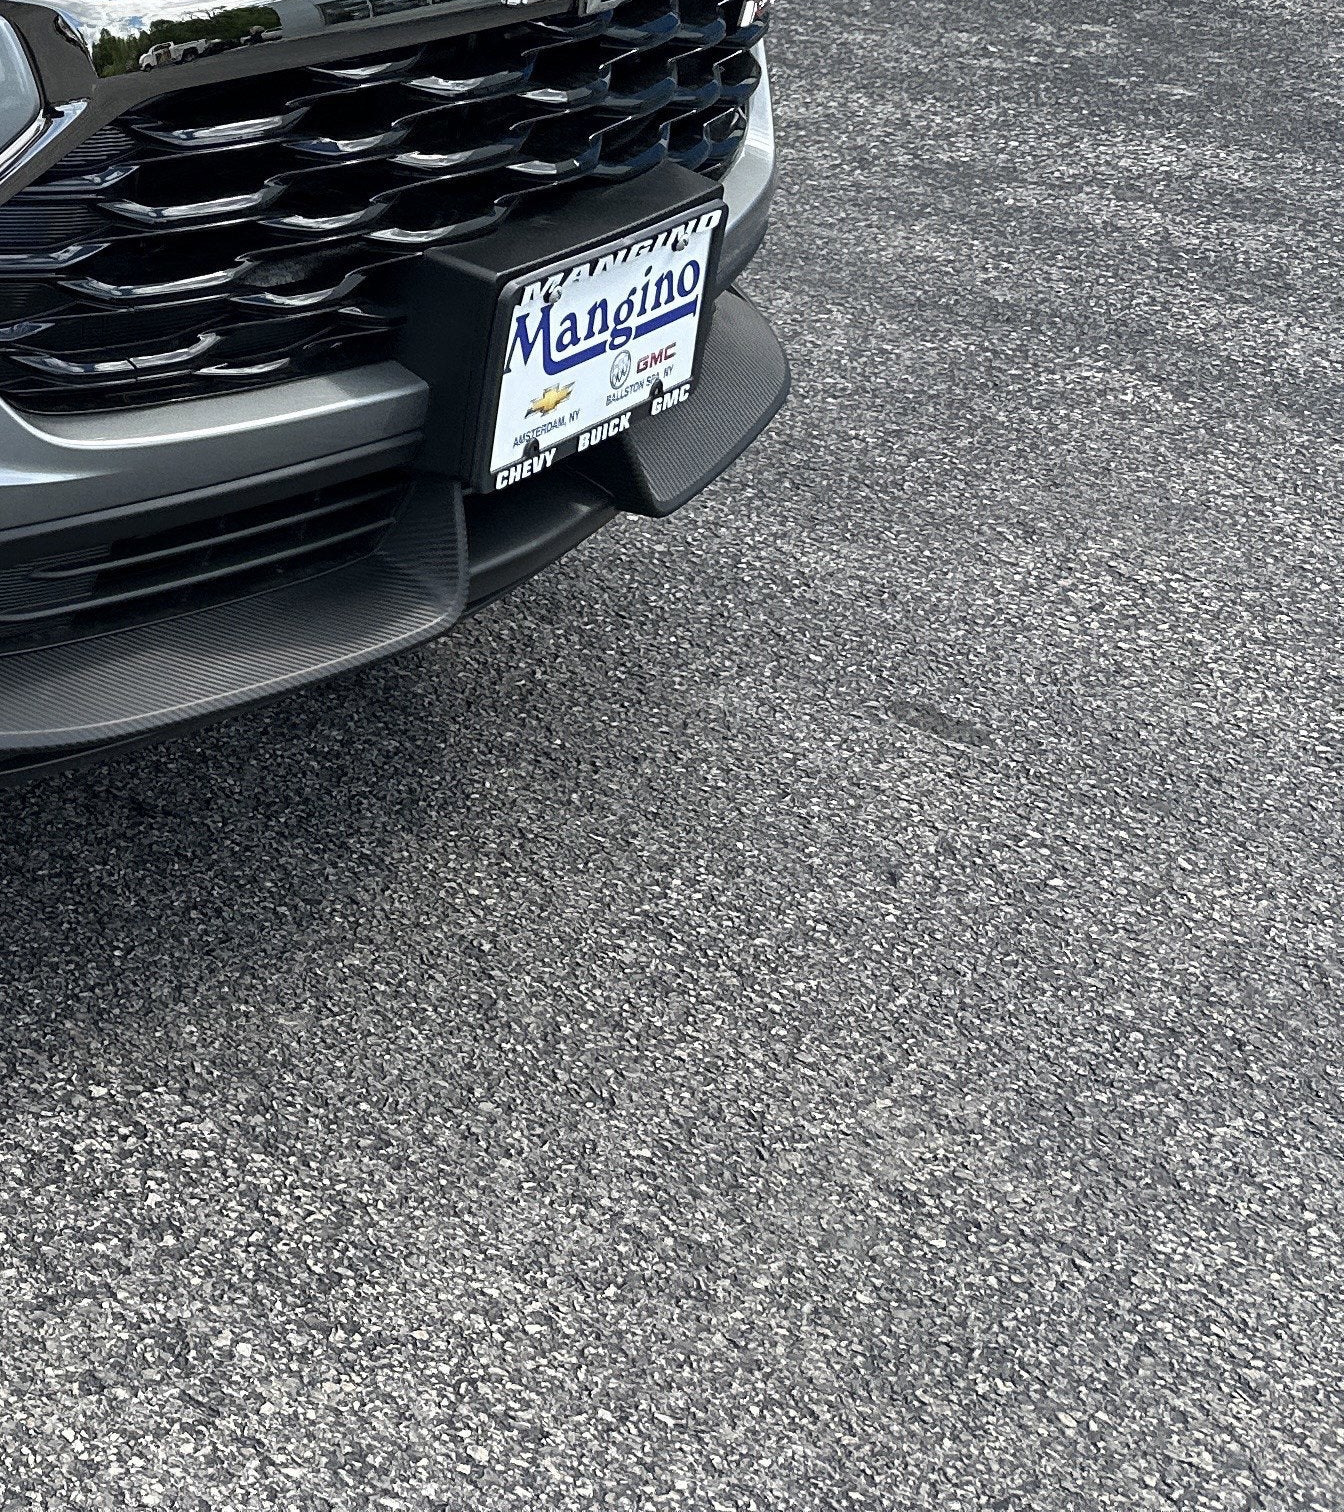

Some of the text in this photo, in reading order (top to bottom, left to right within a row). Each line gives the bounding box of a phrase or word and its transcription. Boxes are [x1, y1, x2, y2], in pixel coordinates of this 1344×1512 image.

[503, 259, 701, 376] Mangino
[636, 341, 677, 374] GMC
[605, 379, 645, 407] BALLSTON
[663, 363, 675, 379] NY
[495, 383, 692, 490] CHEVY BUICK GMC
[569, 408, 581, 424] NY
